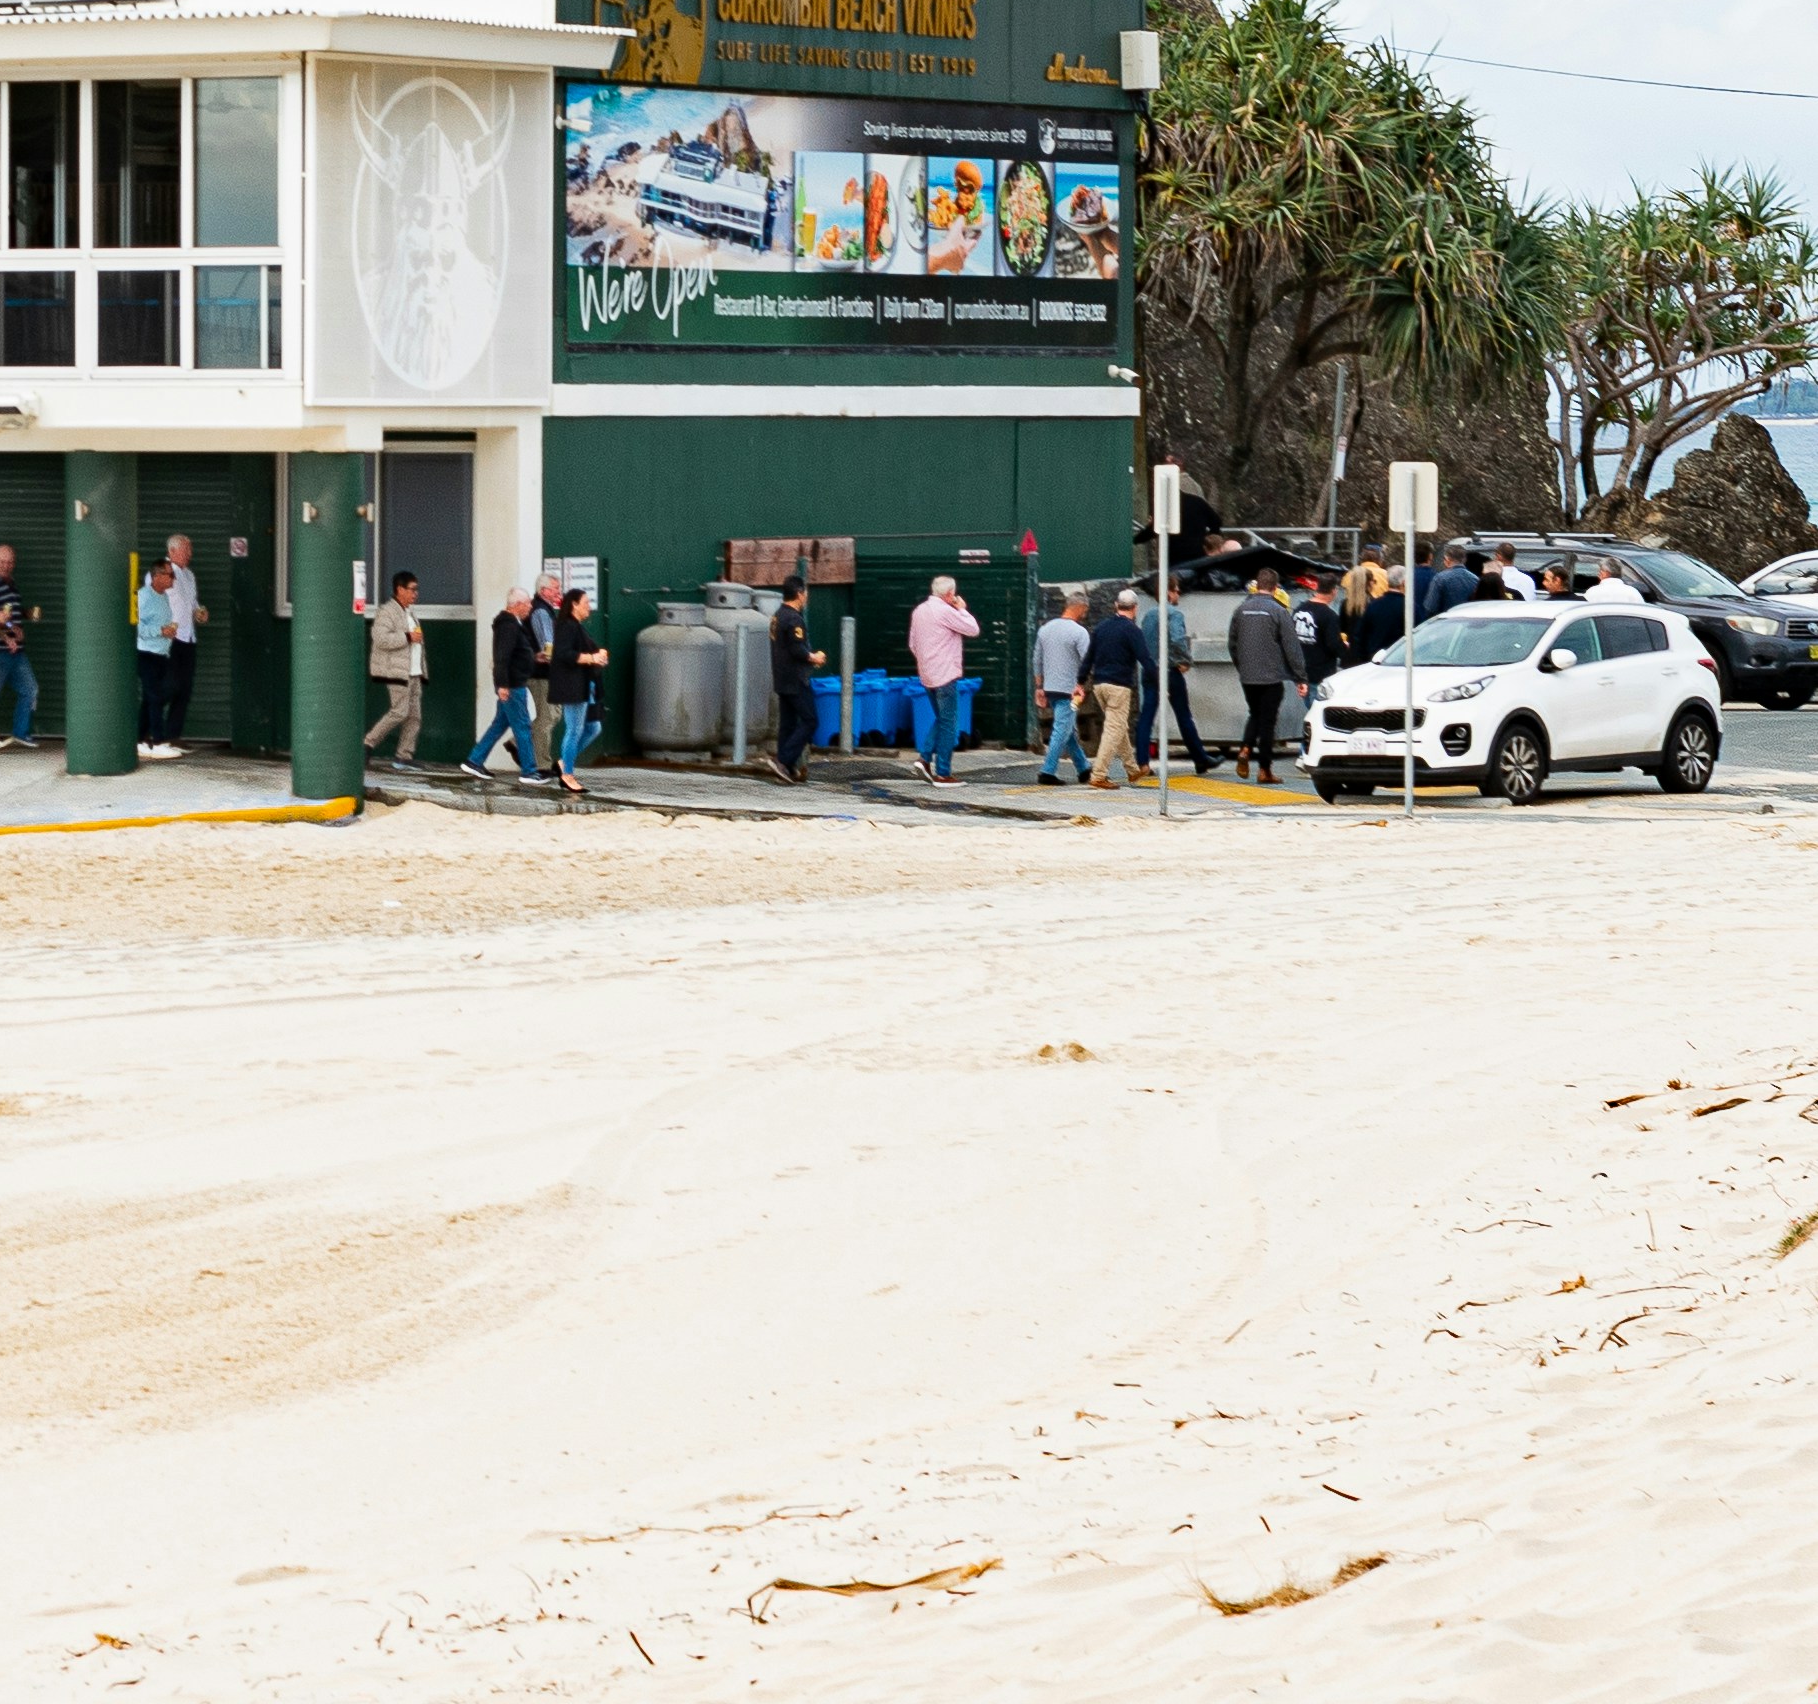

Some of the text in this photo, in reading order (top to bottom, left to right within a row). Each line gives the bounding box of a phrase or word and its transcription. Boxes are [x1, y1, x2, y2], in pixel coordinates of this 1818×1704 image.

[717, 39, 977, 76] SURF LIFE SAVING CLUB EST 1919
[863, 120, 890, 141] Saving
[891, 122, 909, 138] lives
[909, 124, 925, 139] and
[925, 125, 953, 144] making
[953, 126, 989, 142] memories
[990, 127, 1010, 143] since
[578, 235, 718, 338] We're Open
[714, 293, 755, 317] Restaurant
[778, 295, 831, 318] Entertainment
[838, 295, 874, 318] Functions
[902, 296, 920, 319] from
[1039, 301, 1074, 321] BOOKINGS
